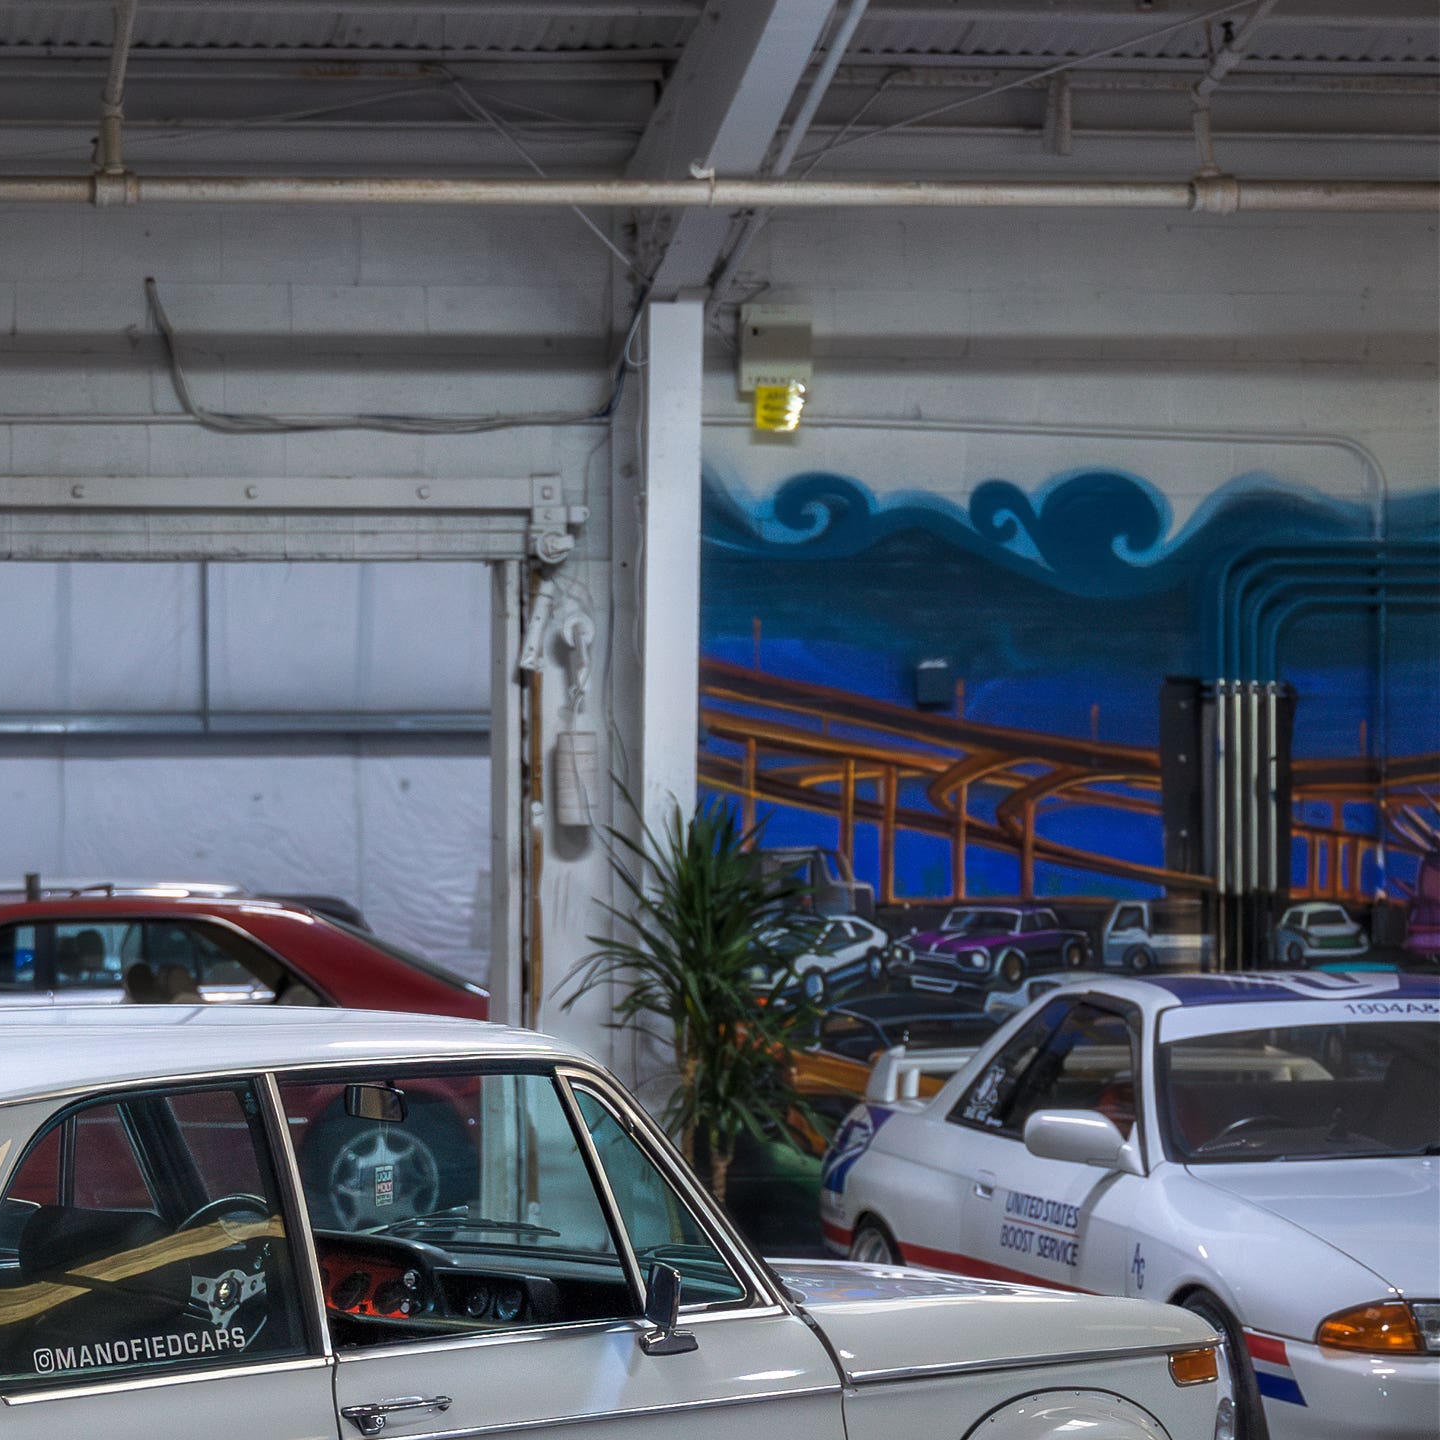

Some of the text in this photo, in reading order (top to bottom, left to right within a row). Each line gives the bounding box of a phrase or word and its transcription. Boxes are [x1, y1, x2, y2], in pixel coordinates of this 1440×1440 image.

[1005, 1191, 1080, 1229] UNITED STATES
[1000, 1224, 1080, 1266] BOOST SERVICE
[54, 1326, 247, 1371] MANOFIEDCARS
